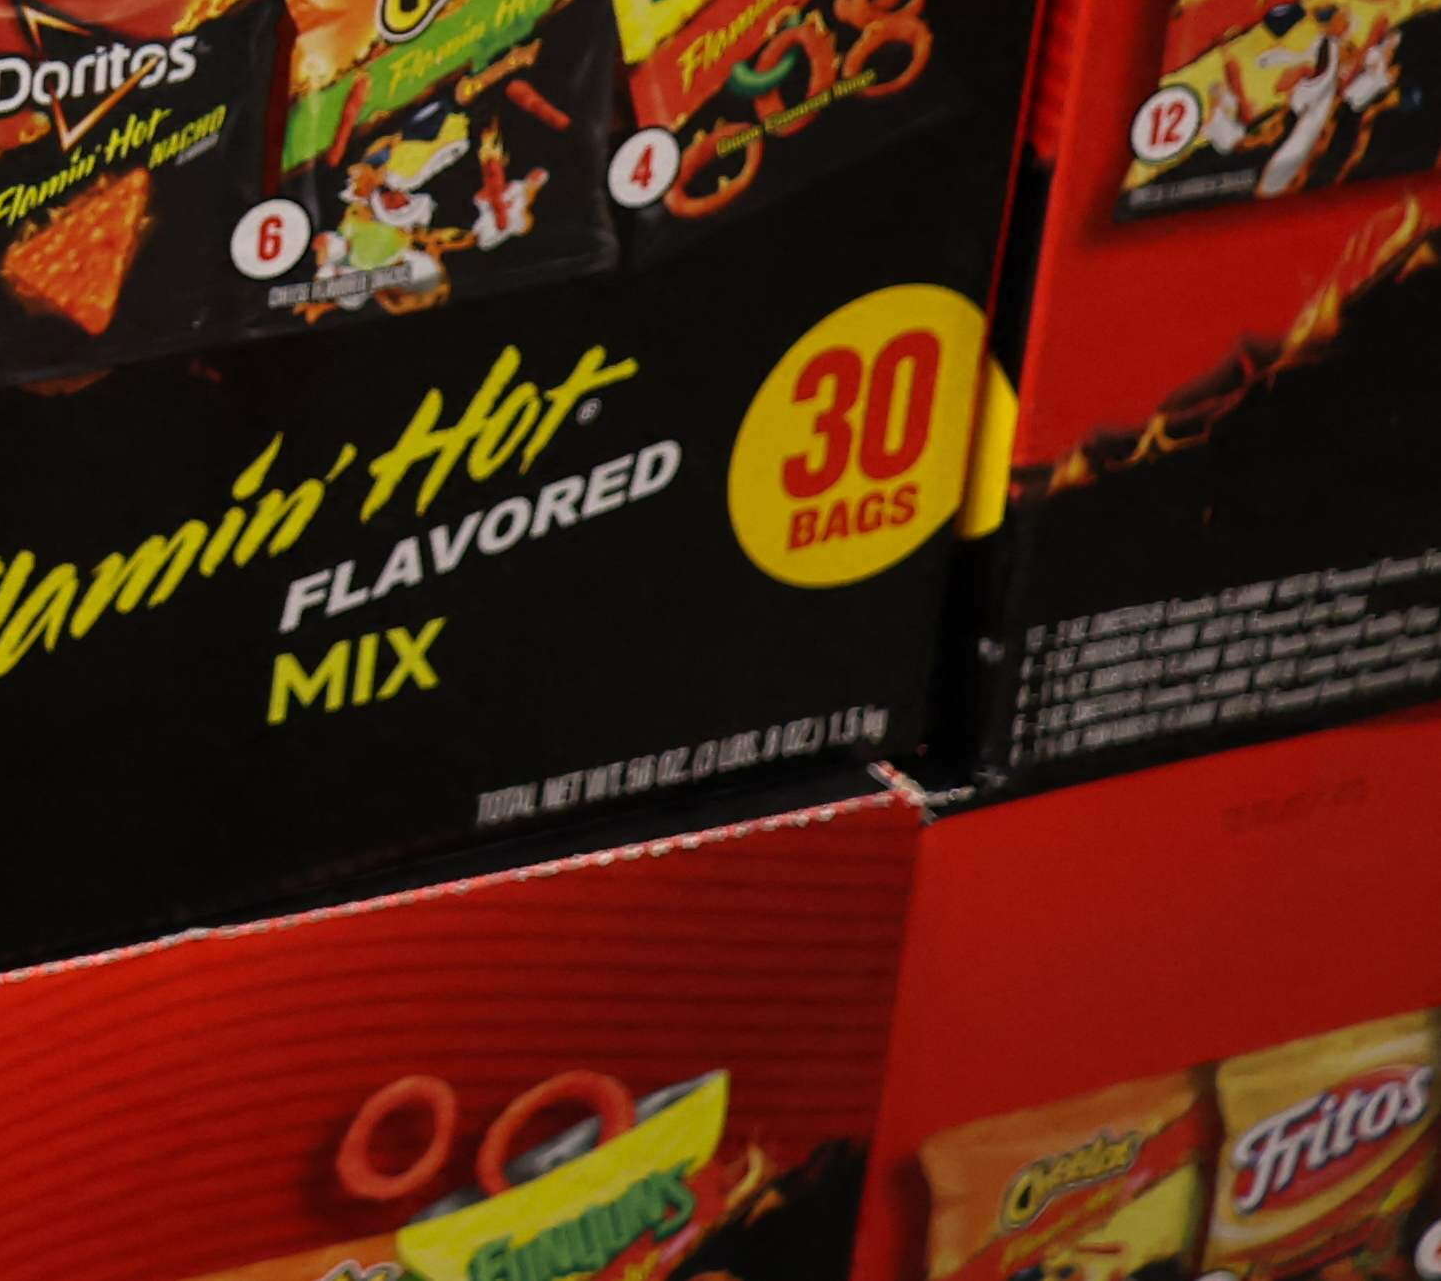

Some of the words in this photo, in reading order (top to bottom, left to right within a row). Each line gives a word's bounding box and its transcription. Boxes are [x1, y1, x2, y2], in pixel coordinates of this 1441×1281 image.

[630, 143, 655, 191] 4
[1149, 102, 1185, 146] 12
[257, 215, 283, 262] 6
[781, 328, 942, 500] 30
[278, 439, 681, 635] FLAVORED
[786, 484, 919, 554] BAGS
[266, 617, 449, 726] MIX
[1232, 1064, 1434, 1215] Fritos
